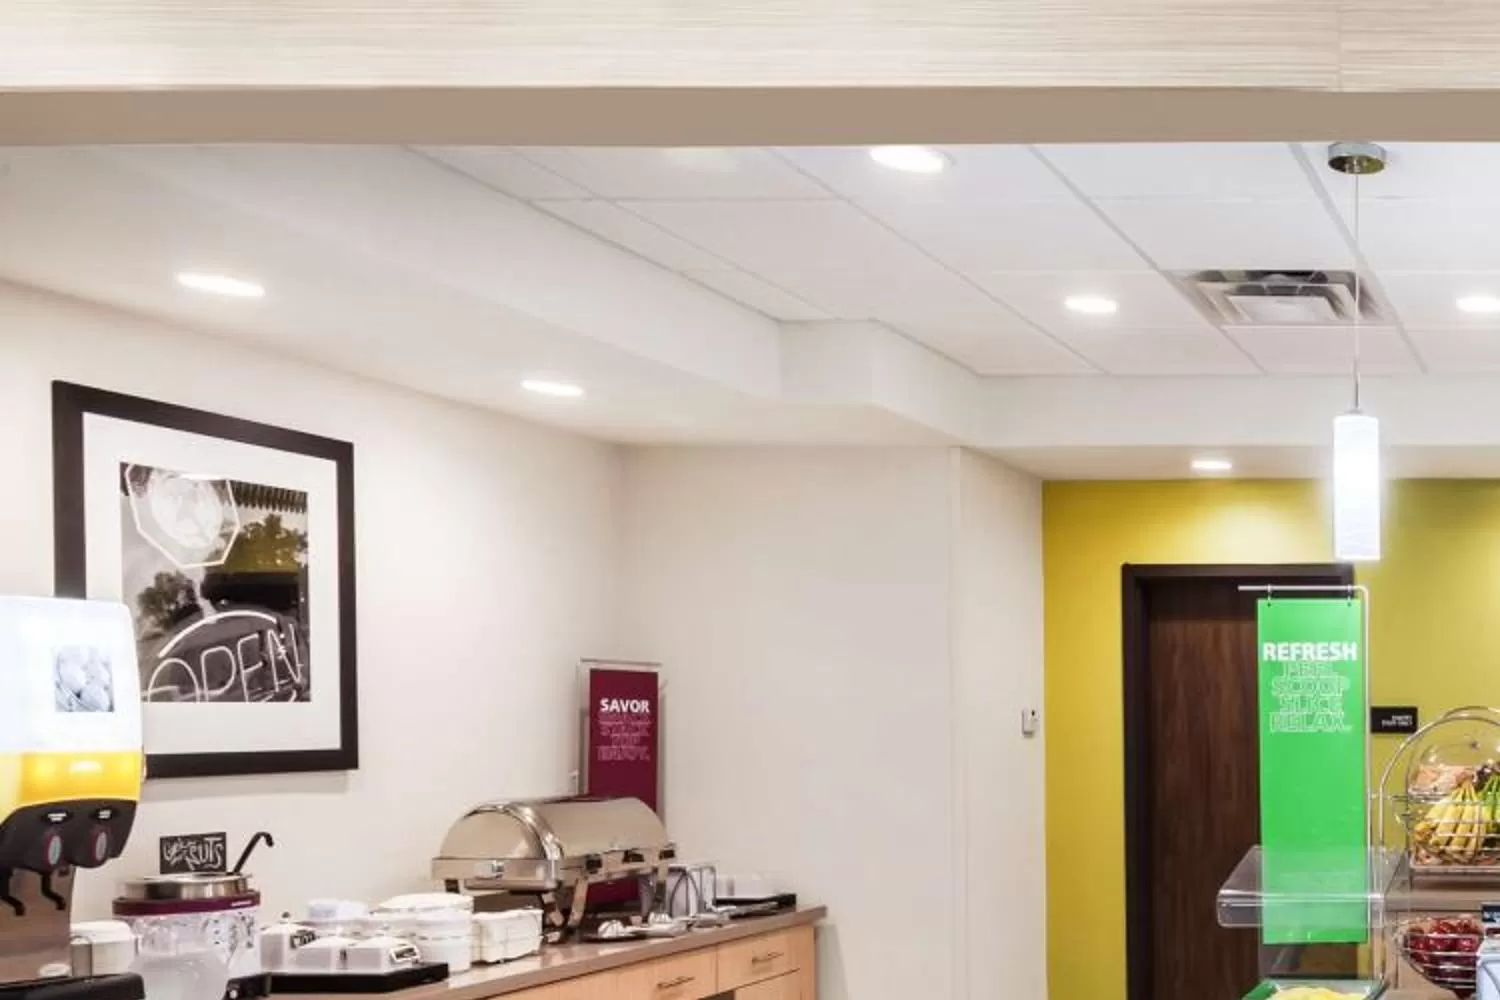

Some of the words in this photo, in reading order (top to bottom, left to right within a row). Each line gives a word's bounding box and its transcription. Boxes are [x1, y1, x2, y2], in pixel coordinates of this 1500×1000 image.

[1263, 641, 1357, 661] REFRESH
[148, 623, 303, 703] OPEN
[600, 698, 650, 713] SAVOR
